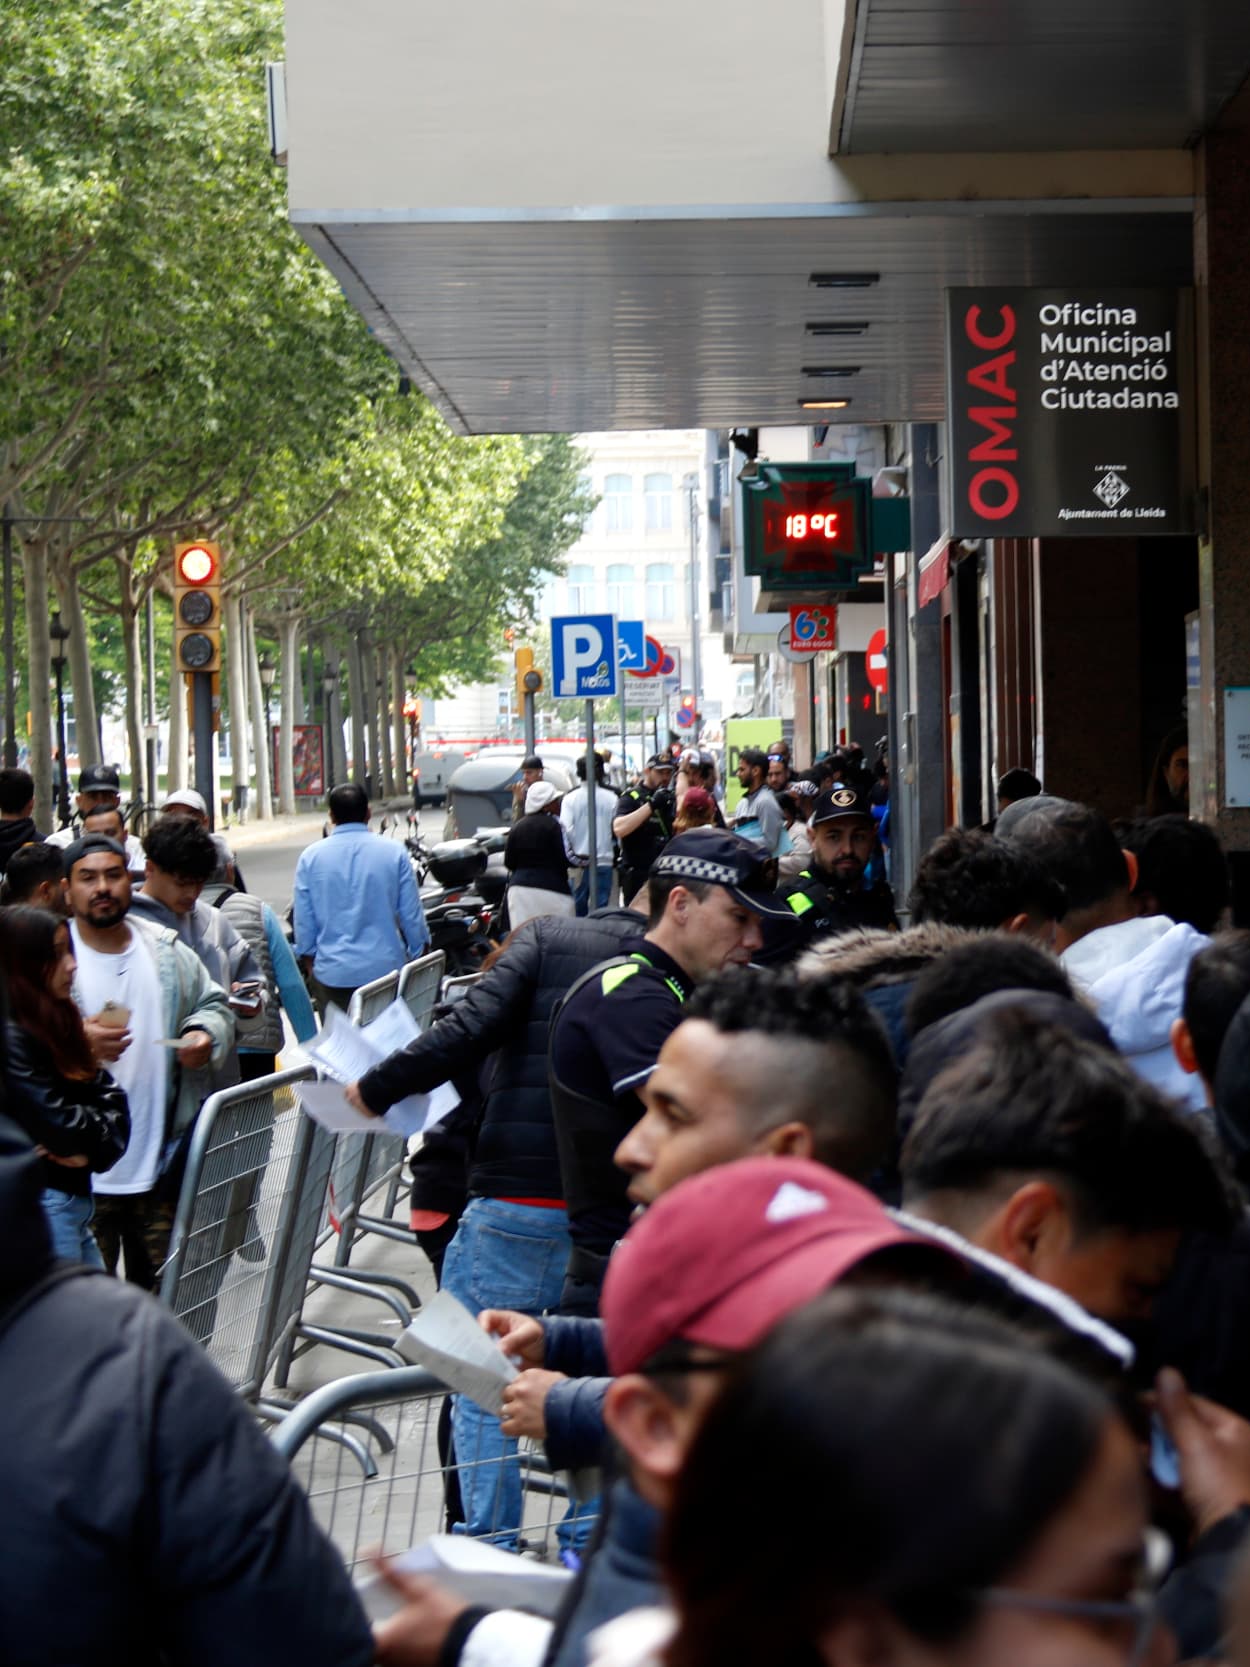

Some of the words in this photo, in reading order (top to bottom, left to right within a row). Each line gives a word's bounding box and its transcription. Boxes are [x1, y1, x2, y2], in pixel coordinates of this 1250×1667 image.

[1039, 302, 1137, 326] Oficina
[1040, 331, 1172, 358] Municipal
[1040, 387, 1179, 410] Ciutadana
[965, 304, 1019, 520] OMAC
[1058, 508, 1118, 520] Ajuntament
[1120, 508, 1133, 518] de
[1135, 507, 1166, 518] Lleida
[561, 623, 603, 695] P
